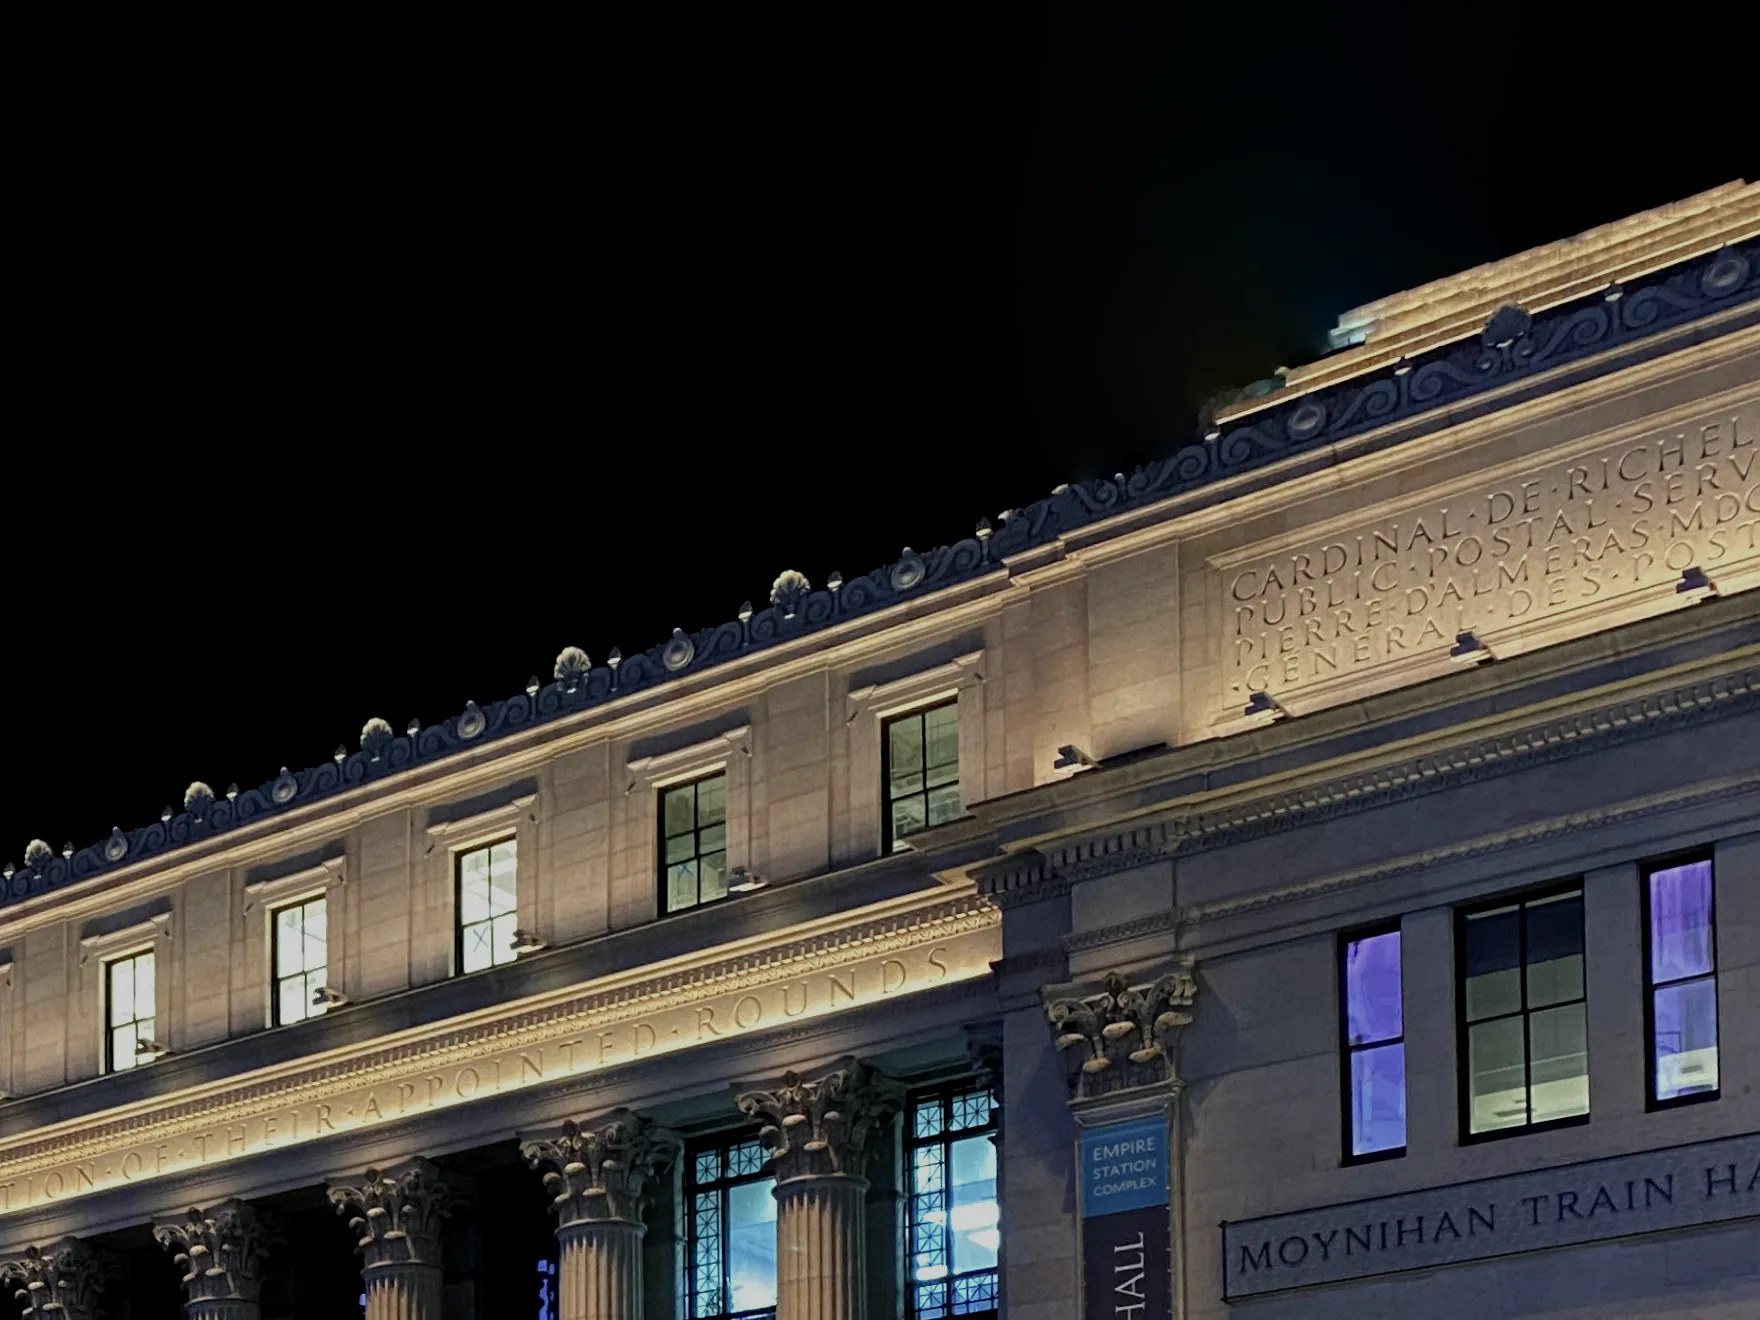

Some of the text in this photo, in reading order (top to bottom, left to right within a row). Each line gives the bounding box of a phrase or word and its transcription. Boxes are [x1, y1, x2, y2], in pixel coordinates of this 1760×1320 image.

[1231, 415, 1754, 601] CARDINAL DE RICHEL
[1235, 448, 1760, 636] PUBLIC POSTAL SERV
[1235, 598, 1382, 667] PIERRE
[1405, 519, 1650, 617] D'ALMERAS
[1507, 565, 1601, 617] DES
[121, 1143, 171, 1181] OF
[194, 1102, 337, 1163] THEIR
[361, 1021, 657, 1123] APPOINTED
[695, 945, 948, 1042] ROUNDS
[1093, 1137, 1157, 1161] EMPIRE
[1093, 1157, 1157, 1180] STATION
[1093, 1176, 1157, 1196] COMPLEX
[1237, 1202, 1498, 1275] MOYNIHAN
[1521, 1173, 1673, 1227] TRAIN
